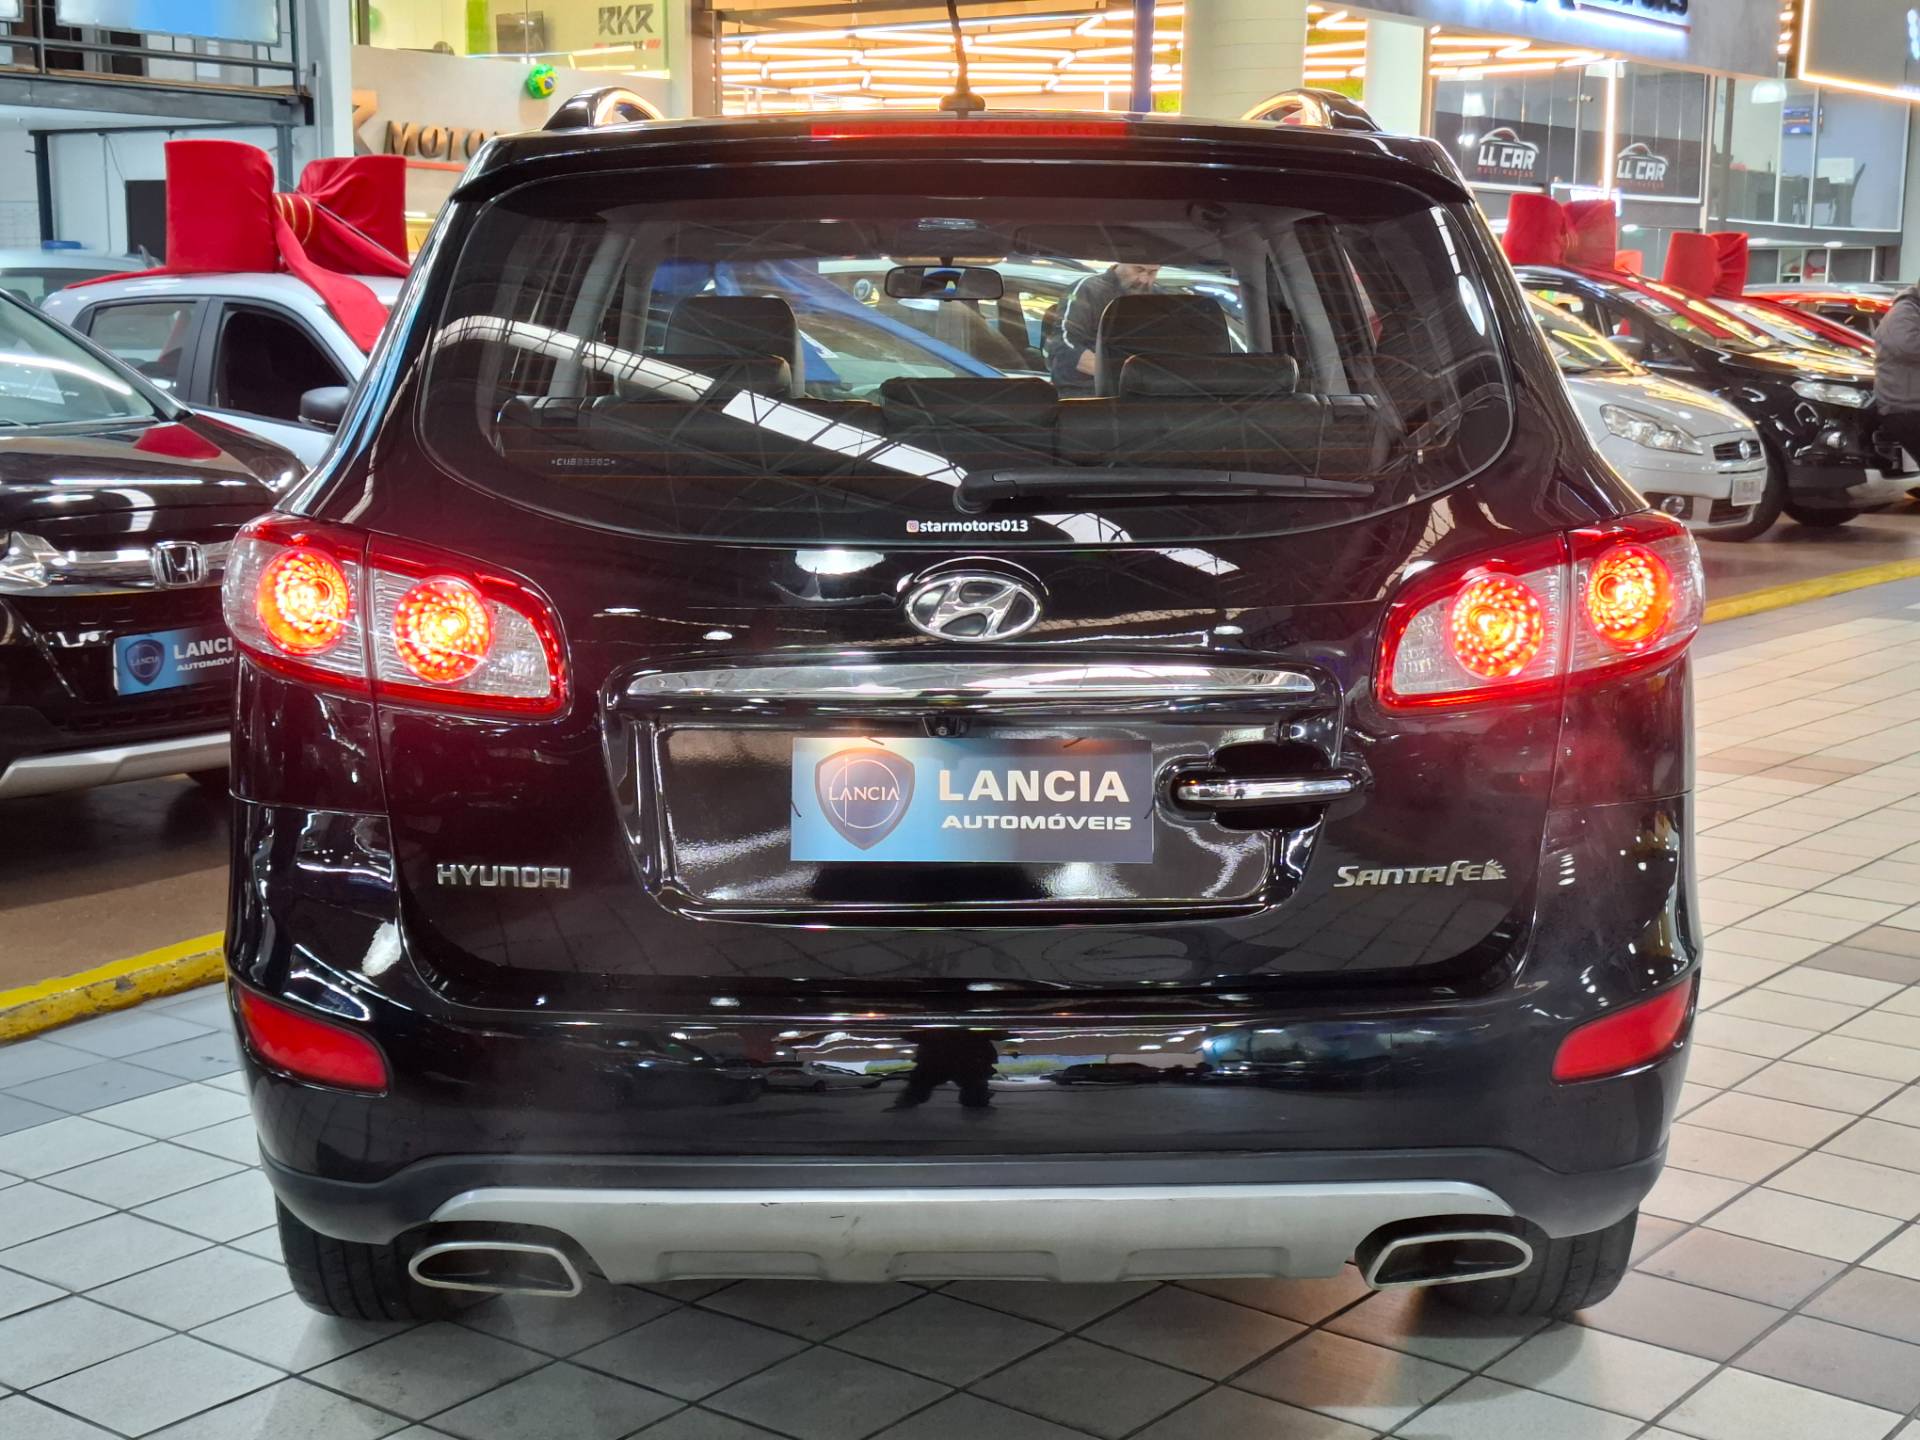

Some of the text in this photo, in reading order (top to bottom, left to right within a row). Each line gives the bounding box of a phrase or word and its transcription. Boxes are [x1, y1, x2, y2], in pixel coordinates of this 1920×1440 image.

[598, 4, 654, 36] RKR
[383, 119, 508, 162] MOTO
[1477, 145, 1537, 170] LL CAR
[1616, 159, 1667, 181] LL CAR
[919, 519, 1029, 533] starmotors013
[173, 637, 233, 660] LANCI
[828, 786, 900, 801] LANCIA
[938, 768, 1131, 803] LANCIA
[941, 811, 1132, 831] AUTOMÓVEIS
[436, 863, 571, 889] HYUNDAI
